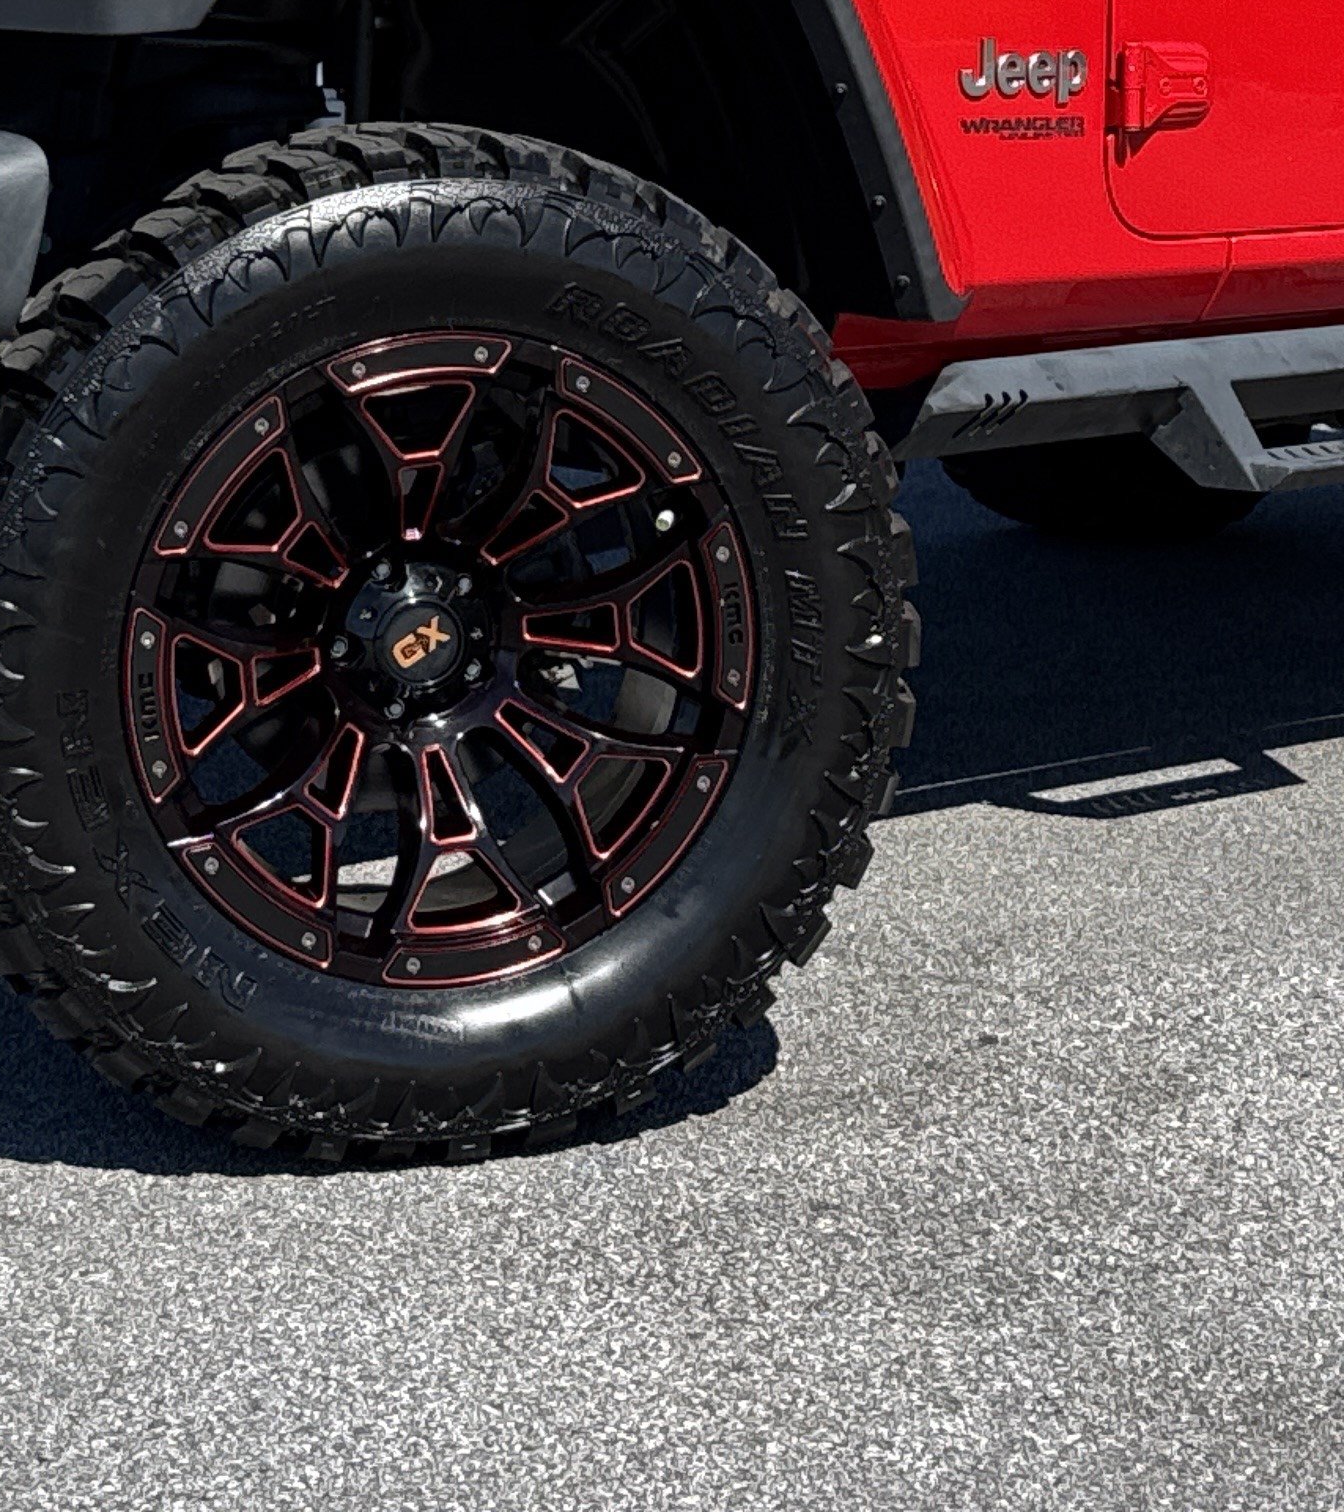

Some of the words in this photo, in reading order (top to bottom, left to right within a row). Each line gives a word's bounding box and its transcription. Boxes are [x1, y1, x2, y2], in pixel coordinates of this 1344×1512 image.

[959, 37, 1088, 106] Jeep
[959, 115, 1085, 133] WRANGLER
[56, 689, 258, 1012] NEXEN
